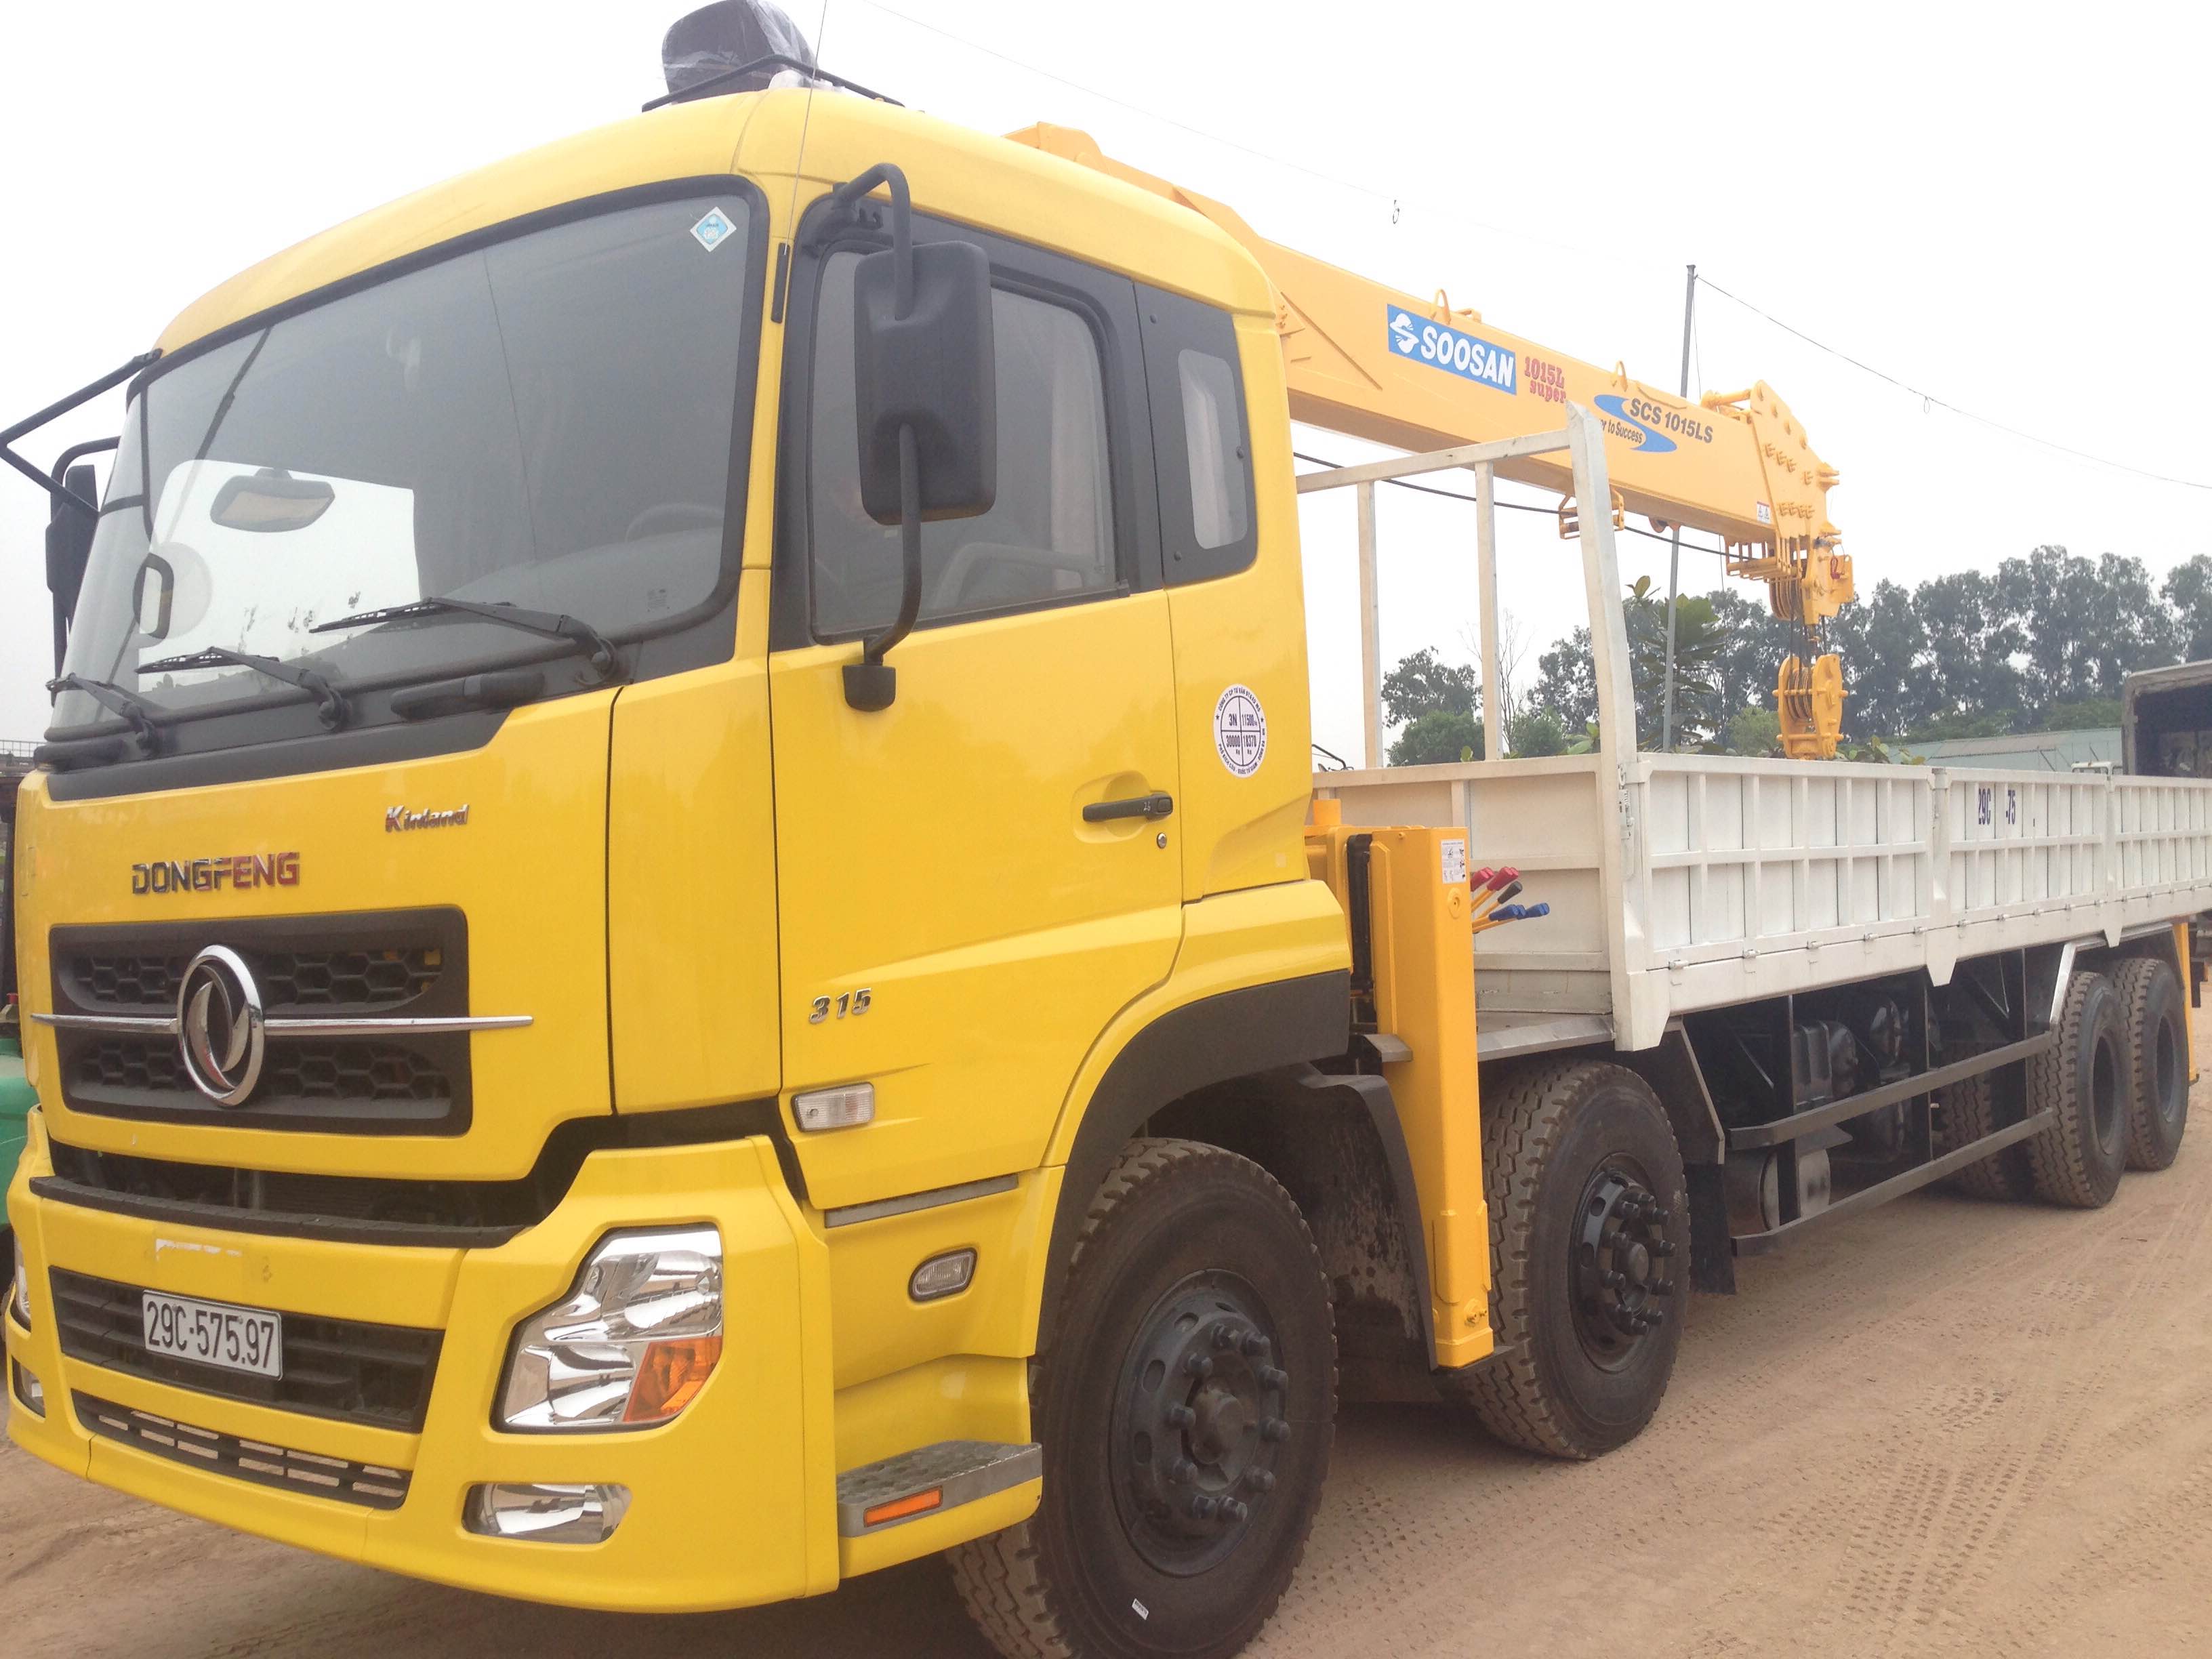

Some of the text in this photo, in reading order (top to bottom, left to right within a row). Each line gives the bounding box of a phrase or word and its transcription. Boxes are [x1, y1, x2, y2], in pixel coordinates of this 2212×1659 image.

[1420, 325, 1514, 387] SOOSAN
[1525, 356, 1565, 389] 1015L
[1616, 421, 1643, 443] Success
[1630, 397, 1661, 425] SCS
[1664, 411, 1713, 443] 1015LS
[1229, 714, 1237, 726] 3N
[1226, 735, 1240, 747] 30000
[1243, 735, 1257, 747] 18370
[386, 804, 469, 833] Kinland
[131, 851, 300, 895] DONGFENG
[808, 987, 872, 1025] 315
[146, 1300, 274, 1369] 29C-575.97
